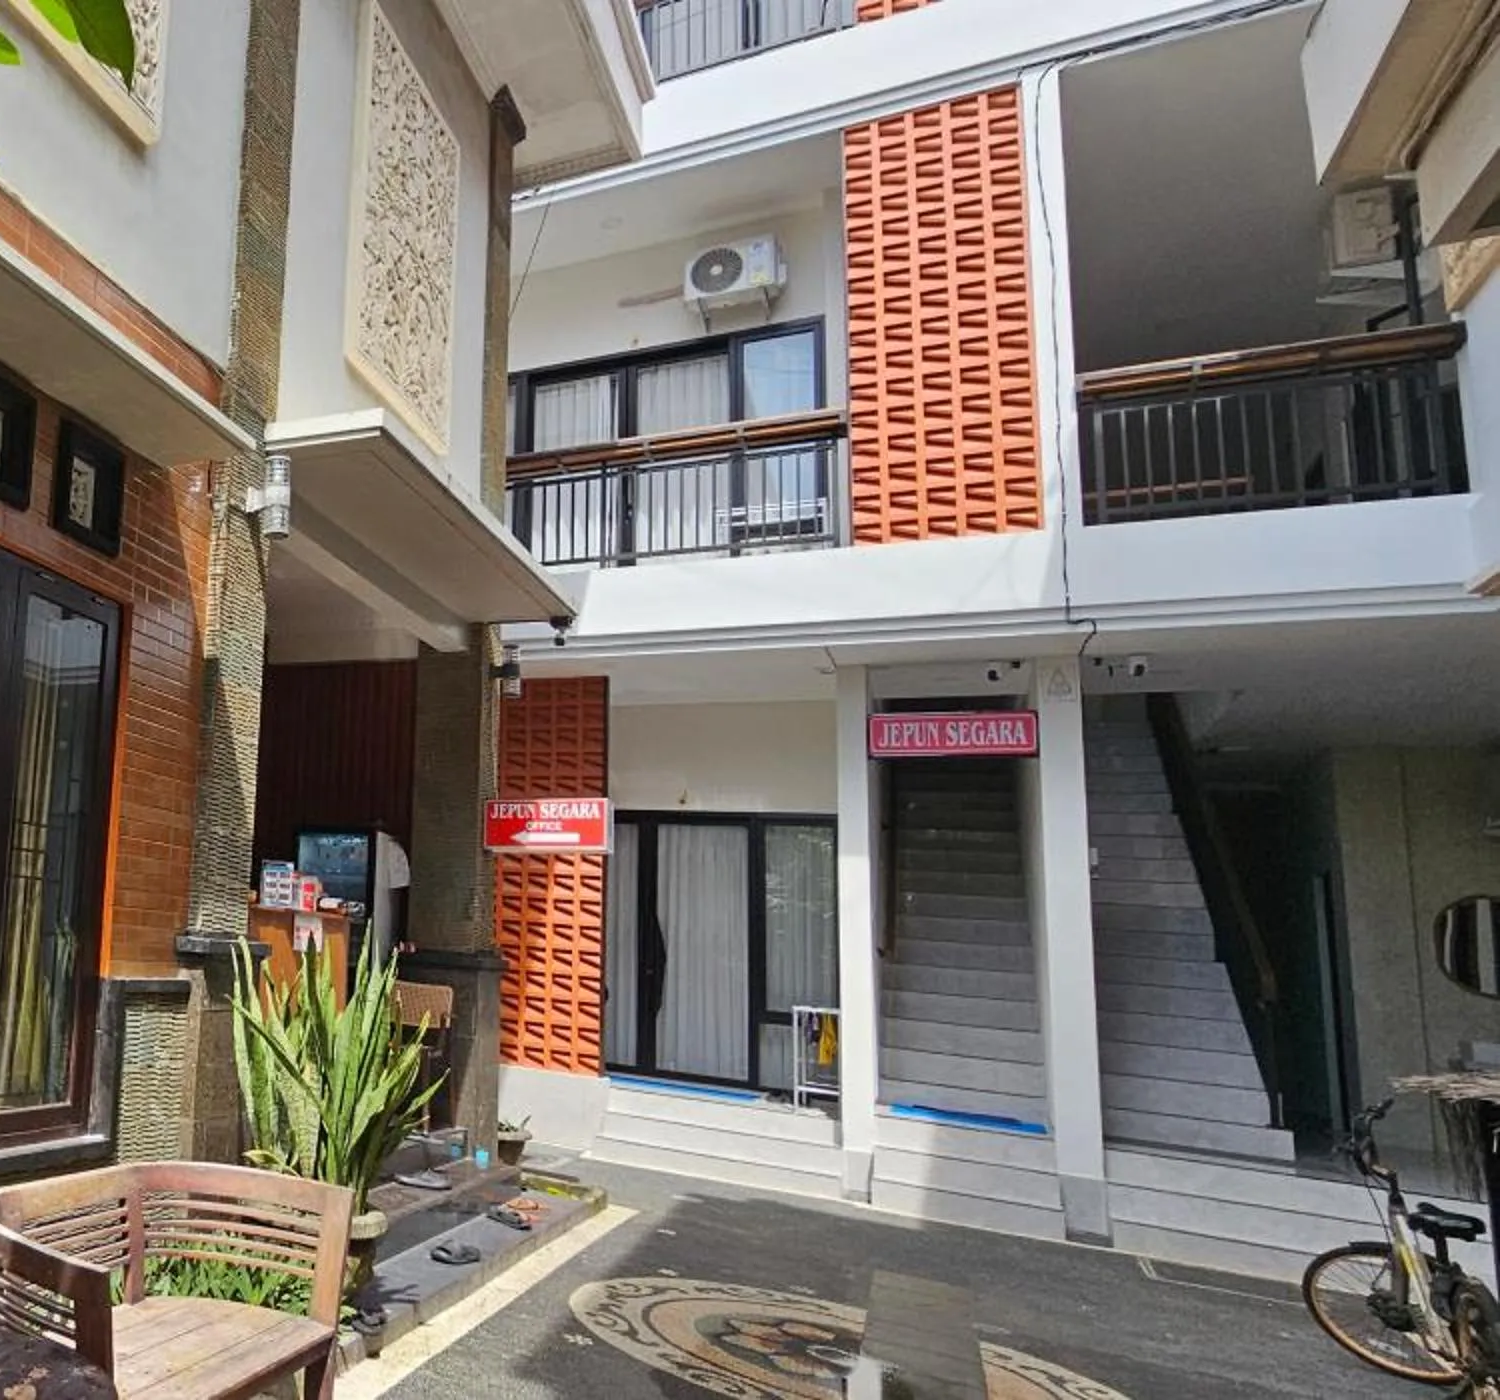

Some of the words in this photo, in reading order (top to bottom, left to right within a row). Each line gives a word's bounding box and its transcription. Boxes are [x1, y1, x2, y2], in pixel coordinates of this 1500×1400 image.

[878, 721, 939, 748] JEPUN
[945, 719, 1028, 746] SEGARA
[490, 803, 537, 819] JEPUN
[539, 803, 600, 819] SEGARA
[525, 821, 563, 831] OFFICE
